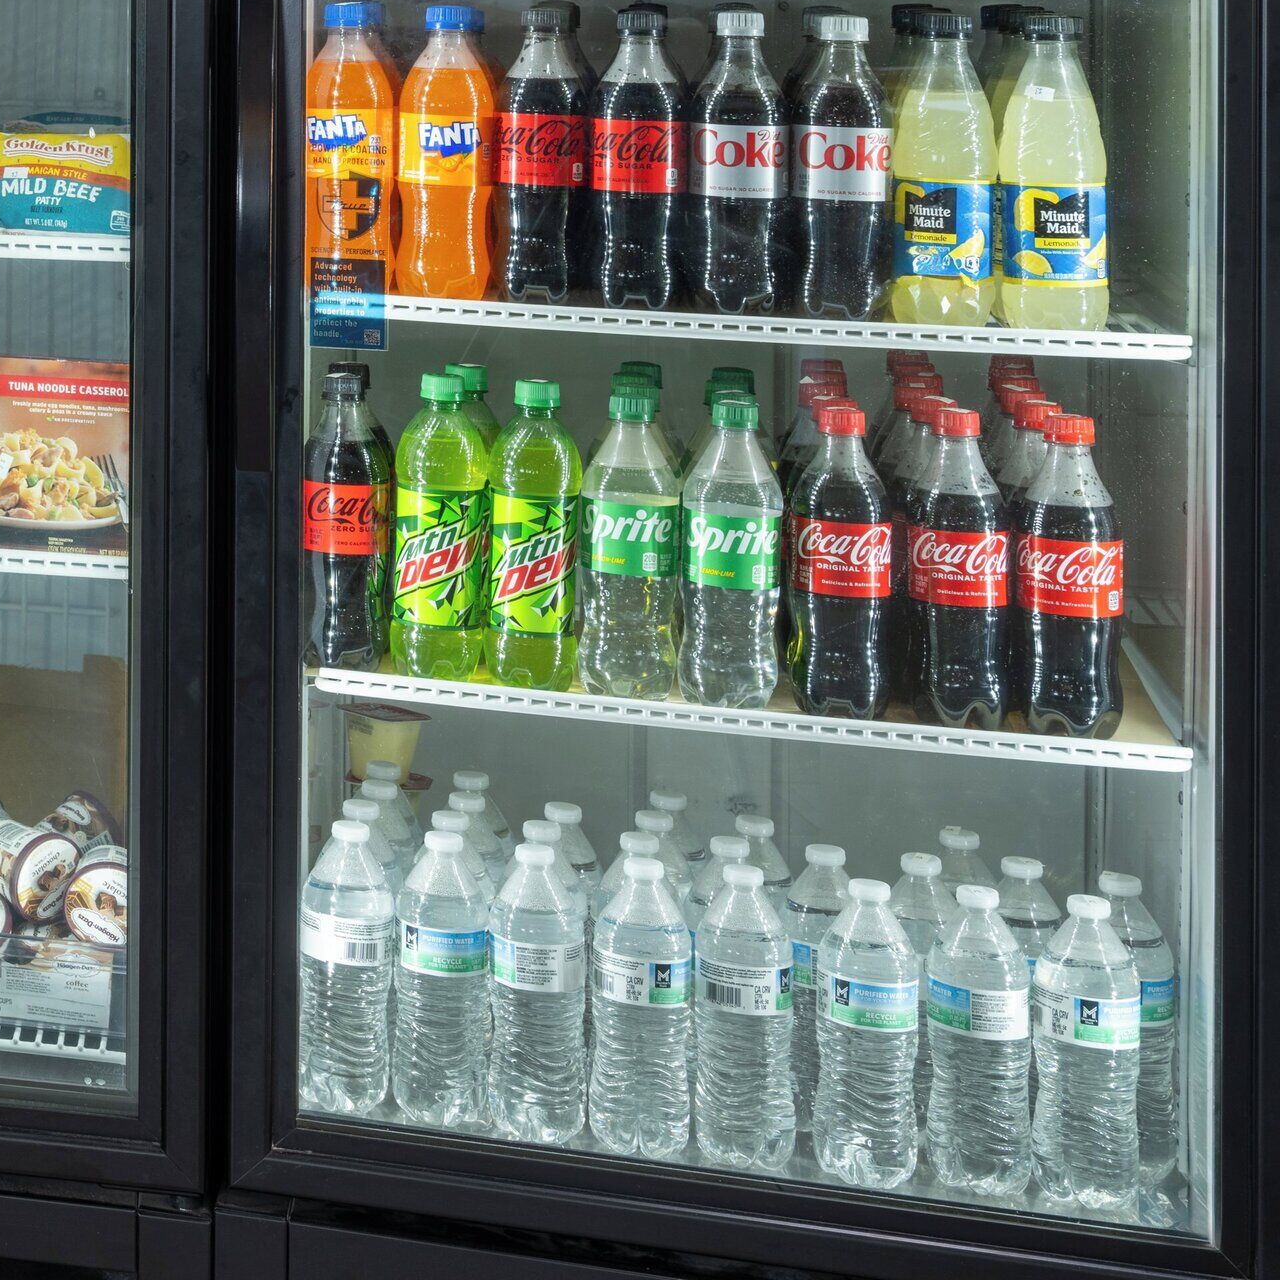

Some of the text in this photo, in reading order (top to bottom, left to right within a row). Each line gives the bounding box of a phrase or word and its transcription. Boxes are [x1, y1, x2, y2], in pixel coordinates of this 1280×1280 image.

[308, 116, 366, 140] FANTA
[867, 132, 888, 146] Diet
[693, 128, 785, 169] Coke
[799, 132, 891, 172] Coke
[527, 156, 560, 164] SUGAR
[1, 178, 46, 196] MILD
[35, 196, 61, 206] PATTY
[909, 203, 951, 220] Minute
[913, 215, 945, 230] Maid
[909, 233, 948, 243] Lemonade
[315, 261, 352, 271] Advanced
[315, 274, 357, 284] technology
[9, 381, 129, 397] TUNA NOODLE CASSEROL
[582, 503, 669, 543] Sprite
[688, 517, 779, 555] Sprite
[799, 523, 892, 565] Coca-Cola
[913, 531, 1008, 574] Coca-Cola
[816, 563, 885, 573] ORIGINAL TASTE
[66, 980, 88, 988] coffee
[854, 988, 909, 1001] PURIFIED WATER
[865, 1011, 897, 1021] RECYCLE
